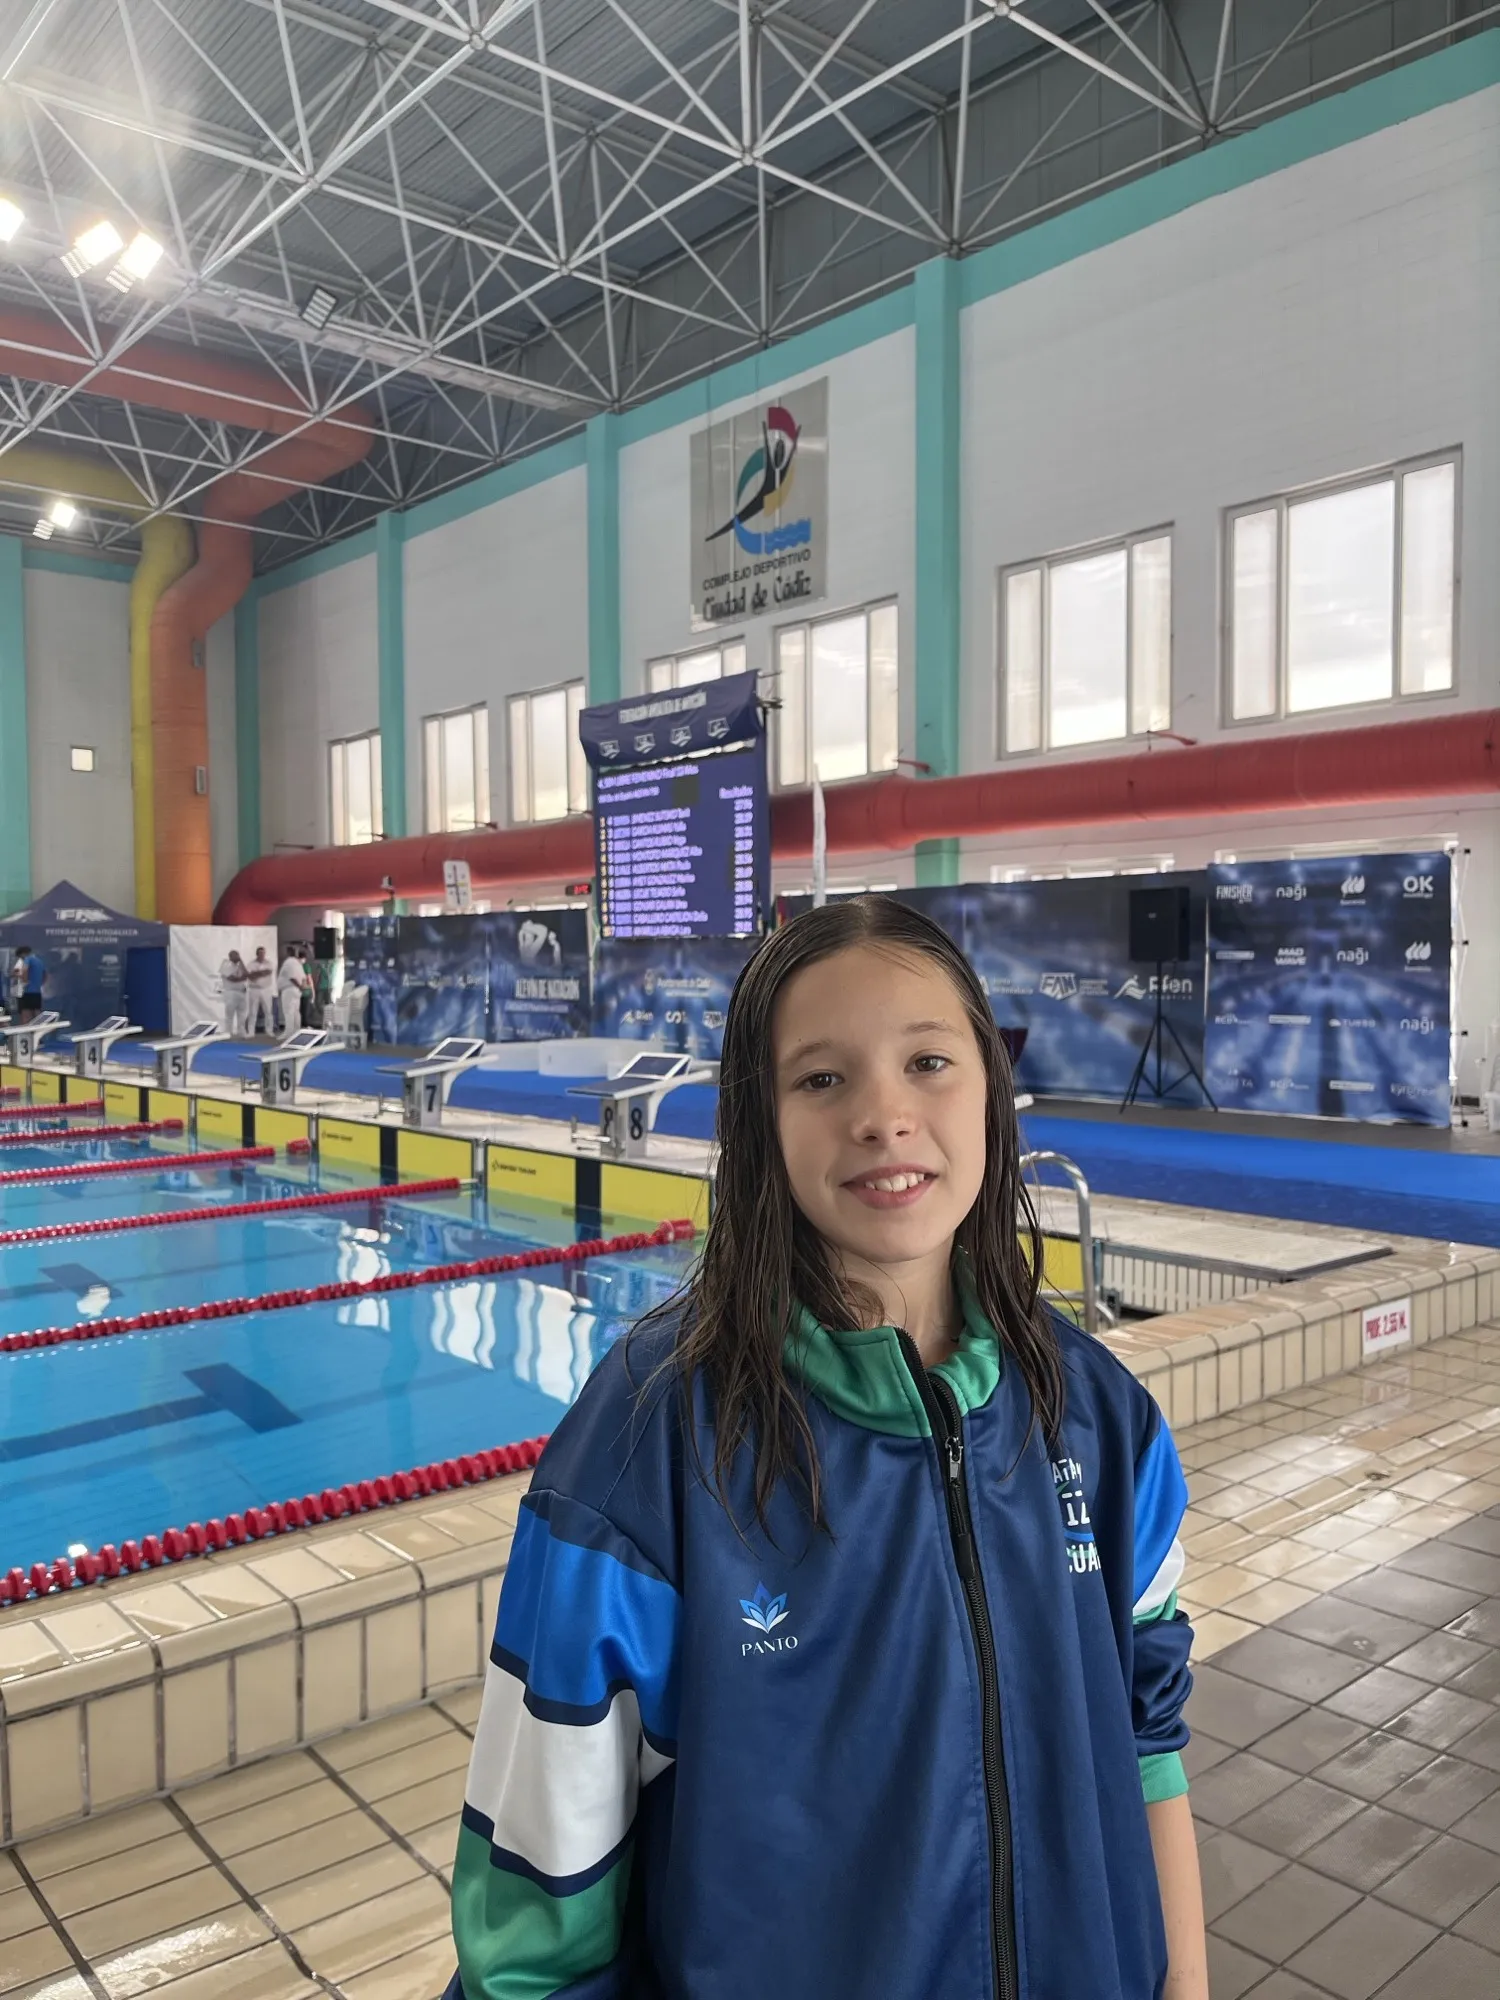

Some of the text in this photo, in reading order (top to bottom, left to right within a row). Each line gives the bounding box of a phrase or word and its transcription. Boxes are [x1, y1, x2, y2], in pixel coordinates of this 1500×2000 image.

[703, 548, 812, 591] COMPLEJO DEPORTIVO
[703, 587, 746, 622] Ciudad
[752, 582, 768, 616] de
[1403, 875, 1434, 893] OK
[20, 1038, 29, 1056] 3
[88, 1046, 97, 1065] 4
[171, 1055, 182, 1077] 5
[279, 1068, 291, 1092] 6
[425, 1084, 438, 1112] 7
[630, 1107, 643, 1141] 8
[741, 1635, 798, 1656] PANTO
